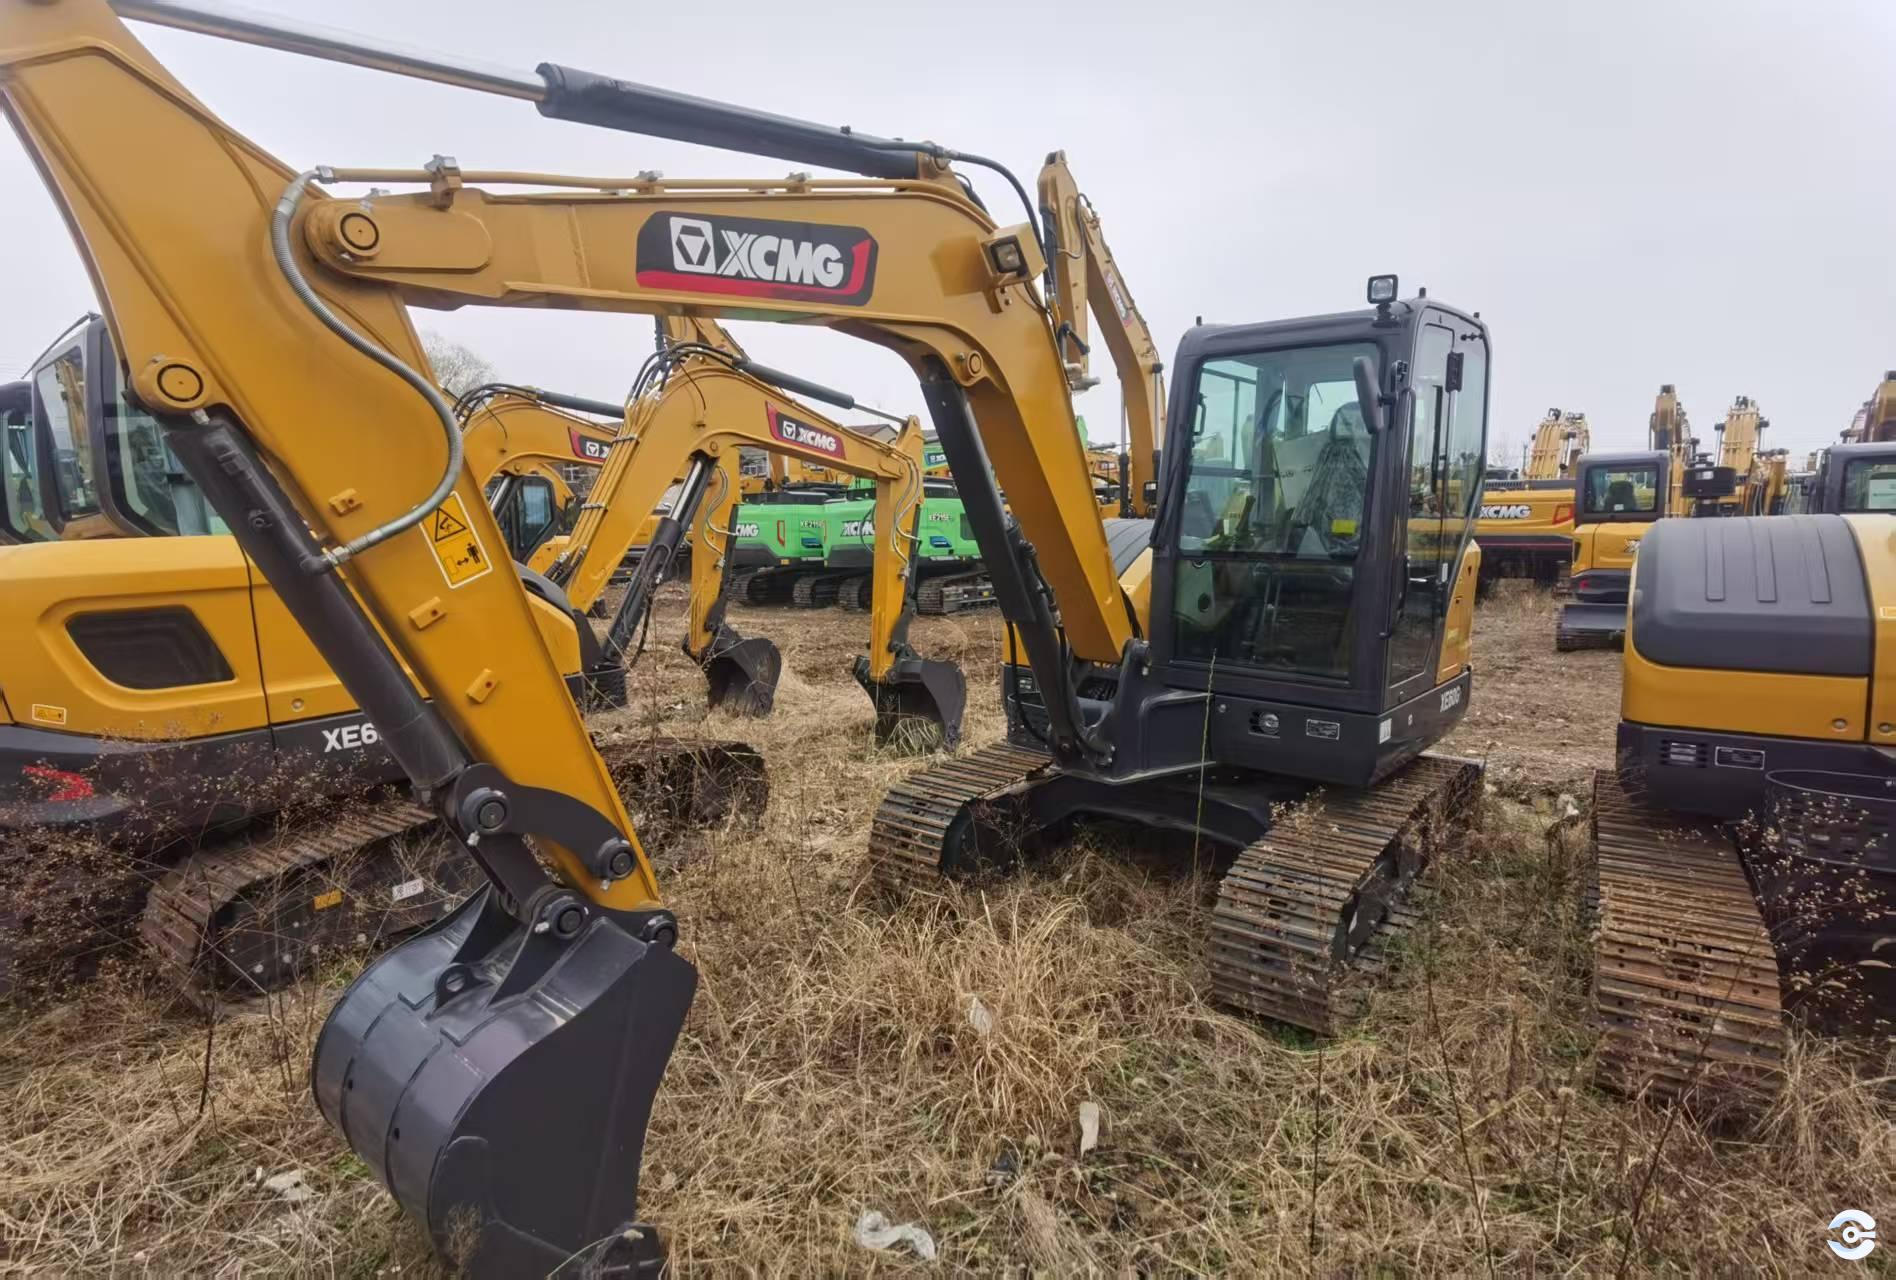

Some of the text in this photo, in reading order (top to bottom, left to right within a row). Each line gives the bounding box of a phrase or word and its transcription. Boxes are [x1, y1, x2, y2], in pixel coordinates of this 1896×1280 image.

[716, 230, 844, 287] XCMG
[797, 427, 837, 451] XCMG
[1480, 504, 1532, 519] XCMG
[735, 523, 759, 537] CMG
[321, 722, 381, 753] XE6
